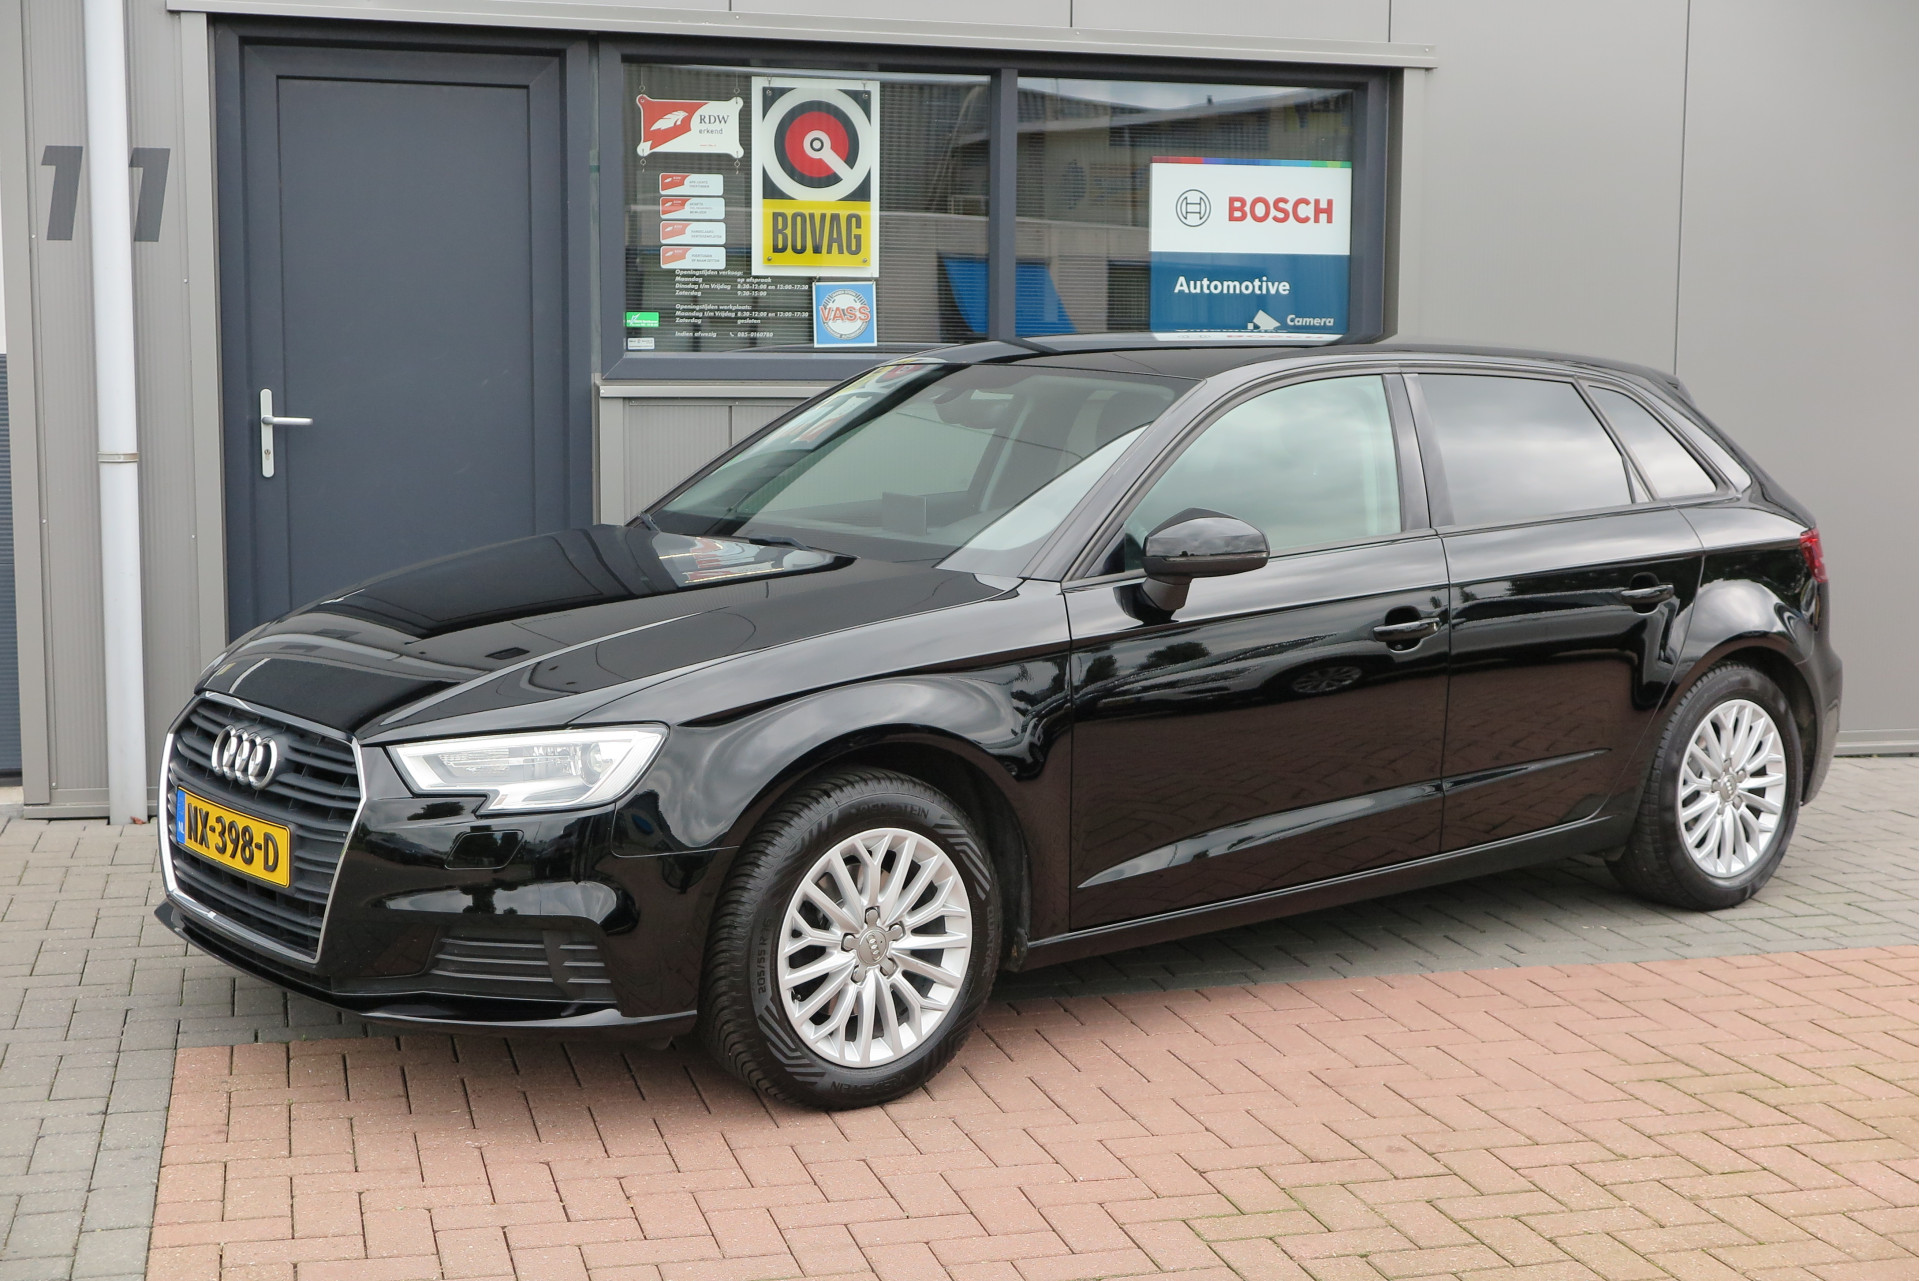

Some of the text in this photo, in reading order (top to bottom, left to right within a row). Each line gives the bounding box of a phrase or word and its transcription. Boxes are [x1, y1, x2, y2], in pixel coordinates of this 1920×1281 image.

[699, 114, 730, 125] RDW
[1228, 196, 1334, 224] BOSCH
[772, 211, 862, 256] BOVAG
[1174, 276, 1290, 295] Automotive
[819, 305, 871, 322] VASS
[1286, 314, 1334, 326] Camera
[187, 803, 279, 872] NX-398-D
